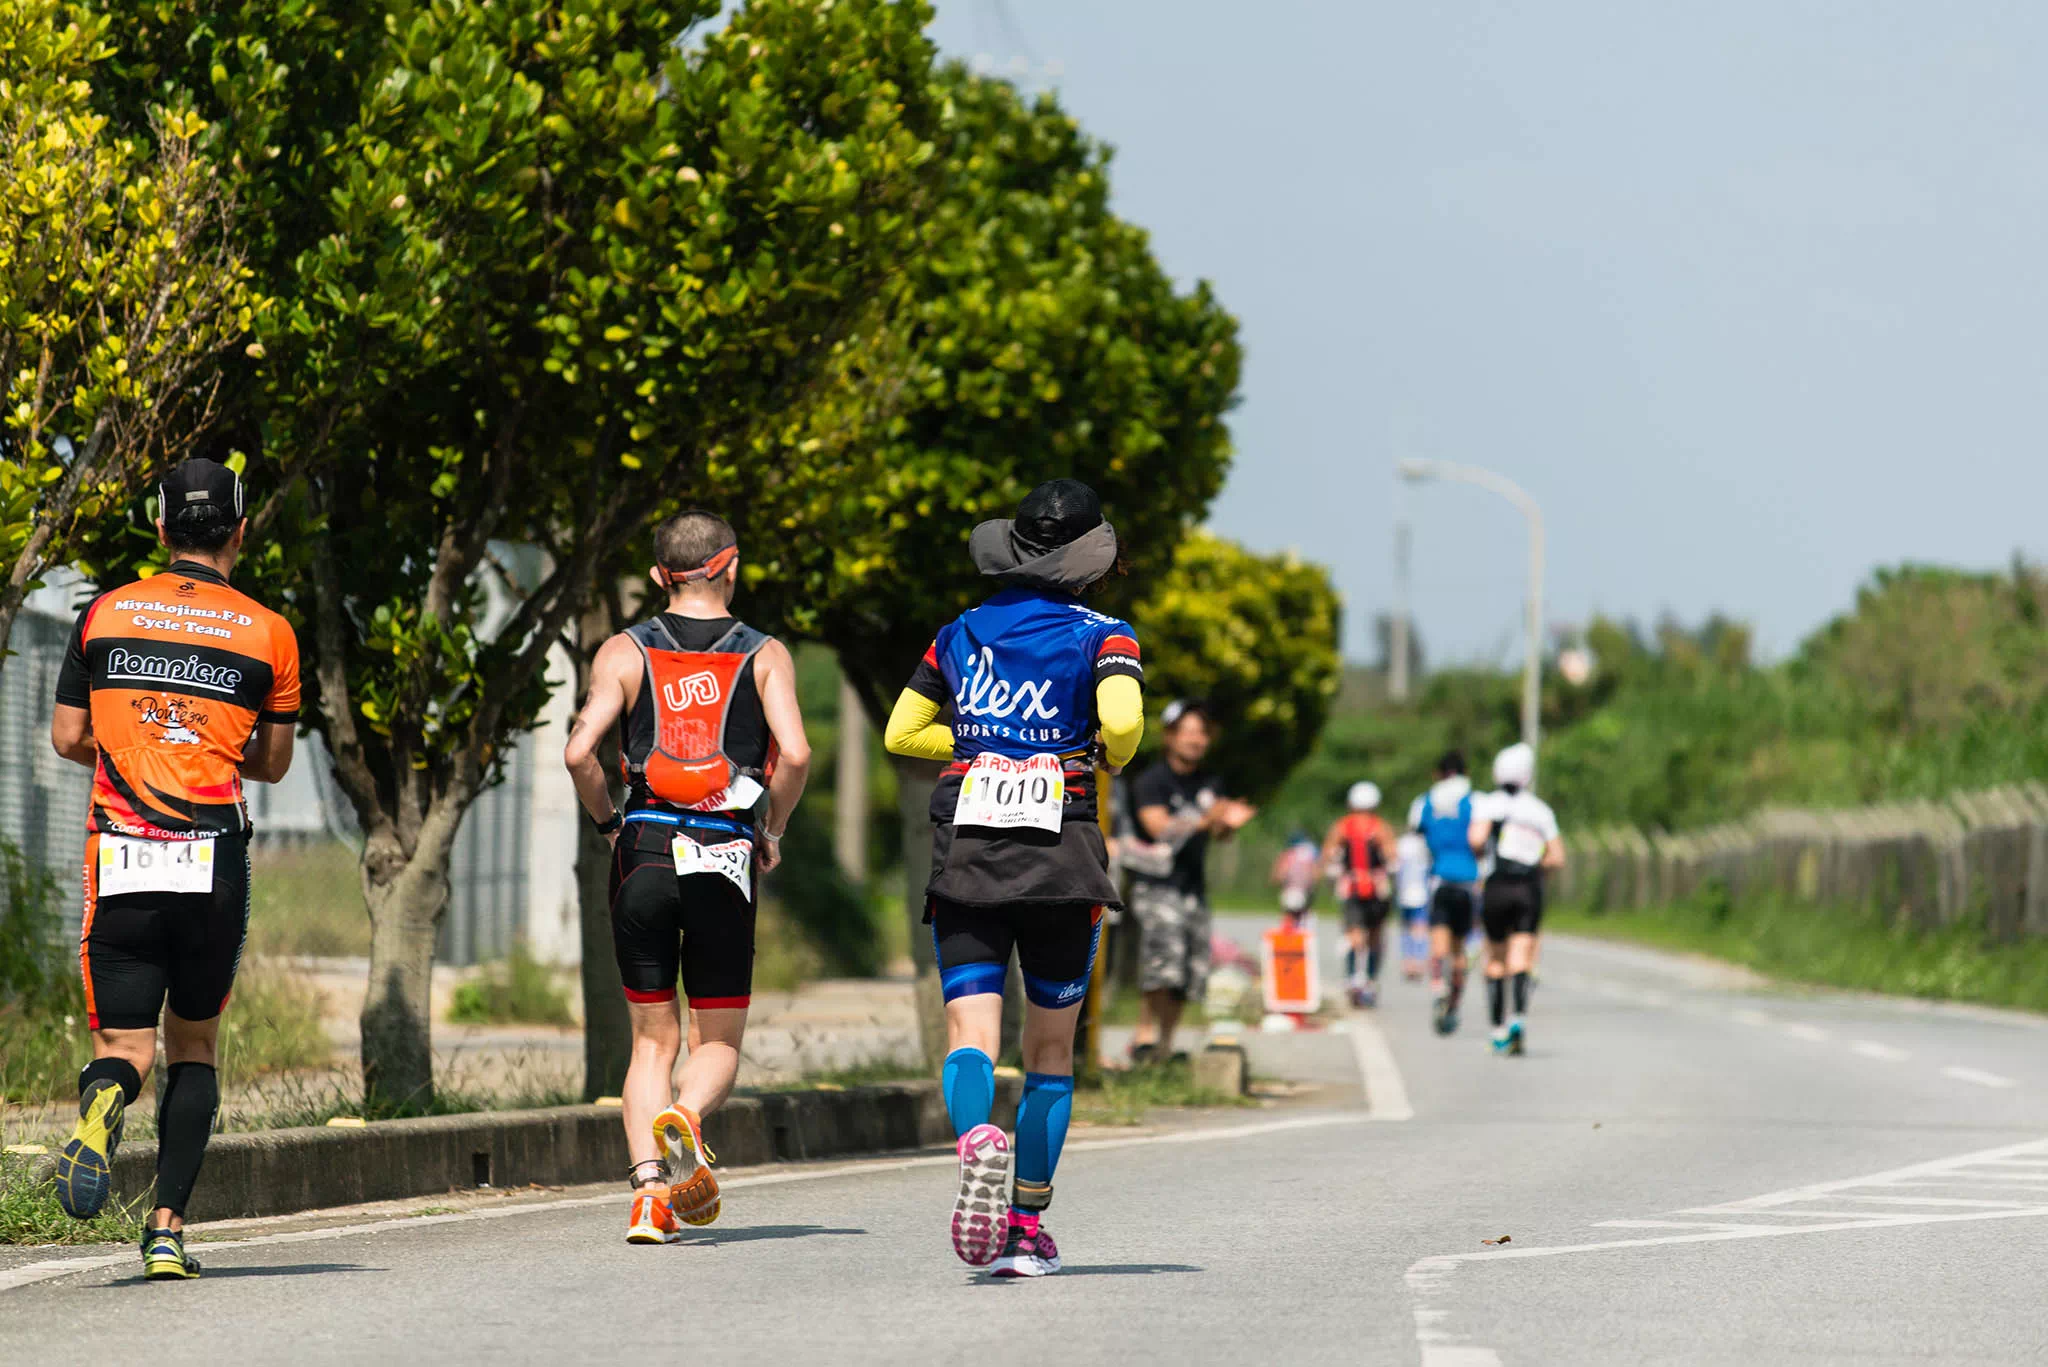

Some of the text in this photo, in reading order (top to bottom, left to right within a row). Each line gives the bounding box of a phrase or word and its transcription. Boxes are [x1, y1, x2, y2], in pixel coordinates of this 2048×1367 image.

[114, 599, 253, 627] Miyakojima.F.D
[132, 615, 232, 639] Cycle Team
[108, 647, 242, 688] Pompiere
[956, 723, 1062, 742] SPORTS CLUB
[980, 776, 1048, 806] 1010
[147, 826, 196, 840] around
[120, 841, 193, 870] 1614
